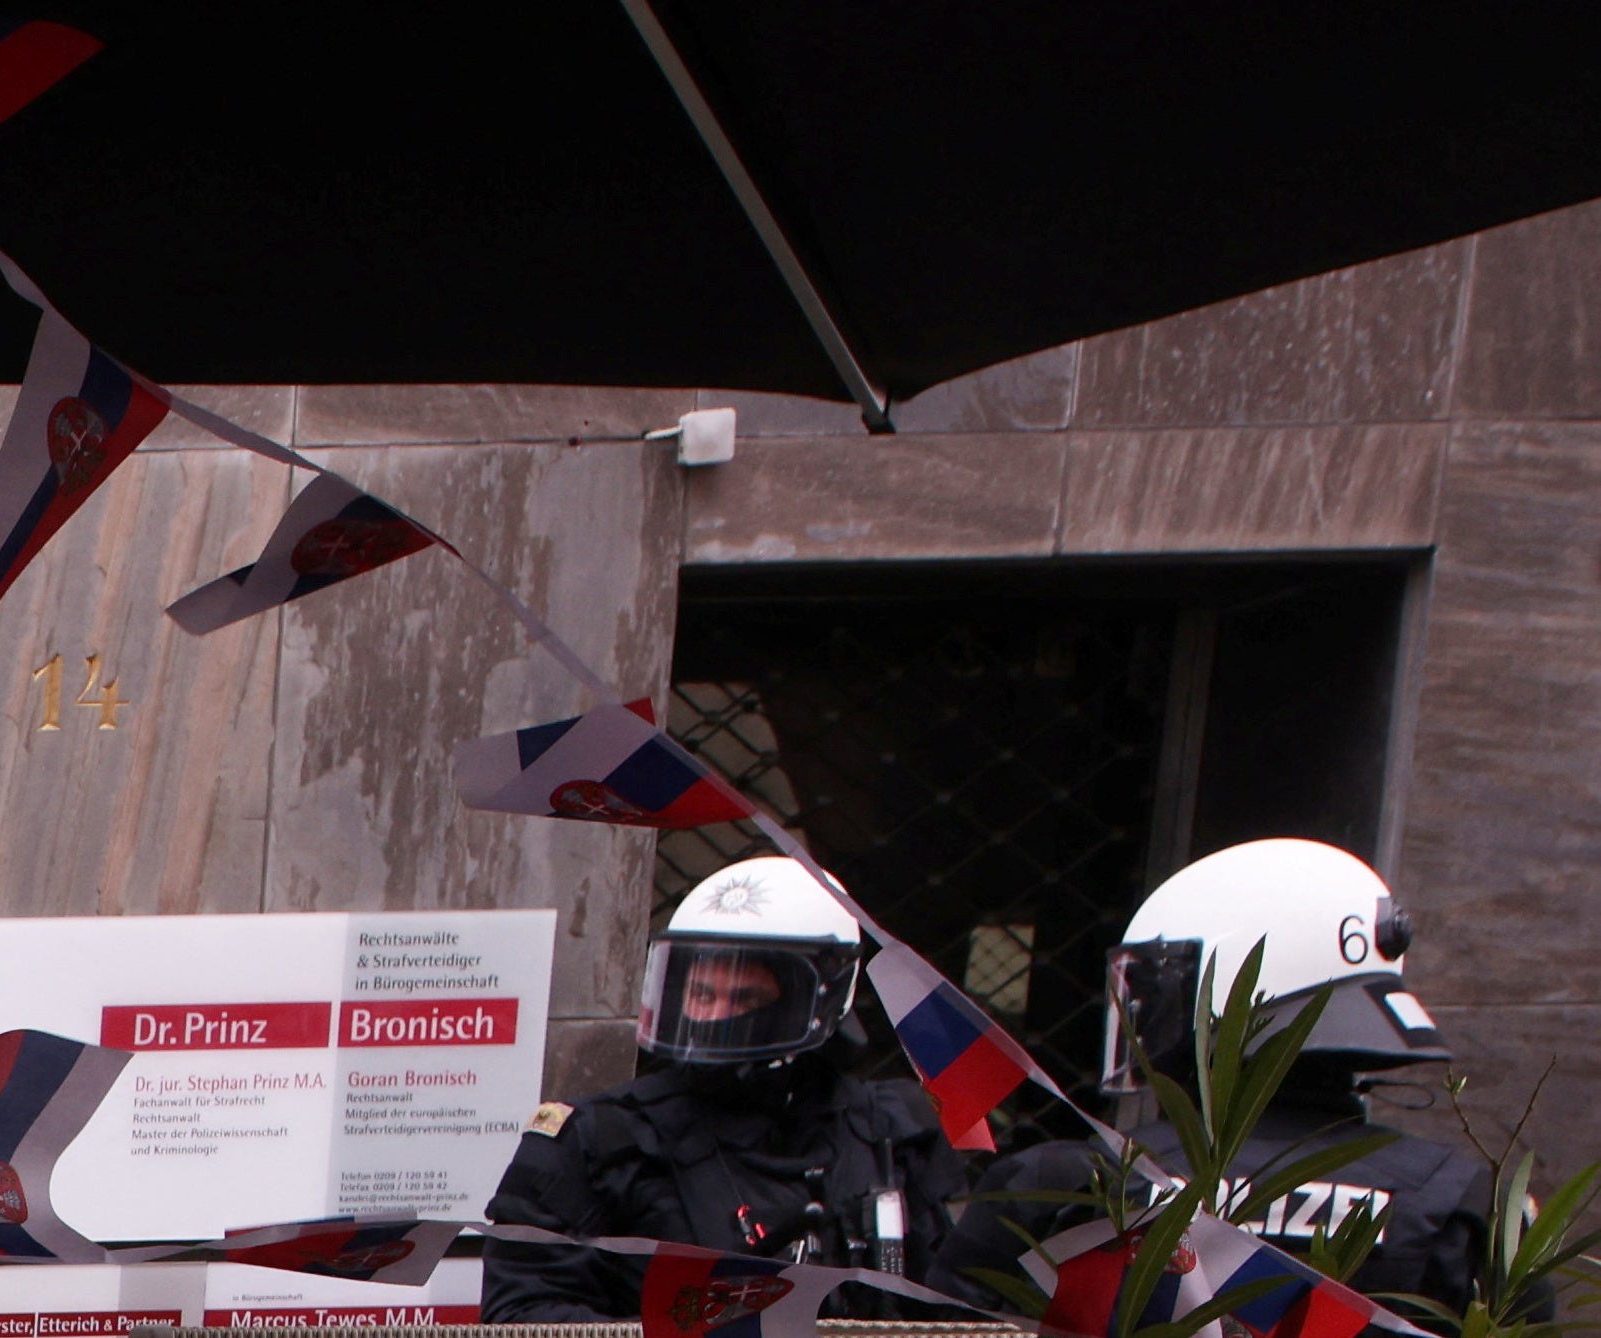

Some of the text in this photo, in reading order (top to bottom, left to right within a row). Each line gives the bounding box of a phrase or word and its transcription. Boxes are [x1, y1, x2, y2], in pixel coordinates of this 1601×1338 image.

[32, 653, 131, 731] 14
[359, 931, 459, 947] Rechtsanwälte
[1339, 914, 1368, 965] 6
[357, 953, 482, 971] & Strafverteidiger
[356, 974, 498, 993] in Bürogemeinschaft
[134, 1008, 494, 1045] Dr. Prinz Bronisch
[136, 1072, 327, 1095] Dr. jur. Stephan Prinz M.A.
[348, 1070, 477, 1088] Goran Bronisch
[134, 1095, 265, 1108] Fachanwalt für Strafrecht
[346, 1092, 413, 1103] Rechtsanwalt
[133, 1112, 201, 1124] Rechtsanwalt
[346, 1107, 476, 1121] Mitglied der europäischen
[131, 1127, 288, 1140] Master der Polizeiwissenschaft
[344, 1122, 481, 1136] Strafverteidigervereinigung
[131, 1144, 218, 1158] und Kriminologie
[39, 1315, 99, 1333] Etterich
[103, 1319, 113, 1331] &
[231, 1311, 306, 1327] Marcus
[315, 1309, 377, 1327] Tewes
